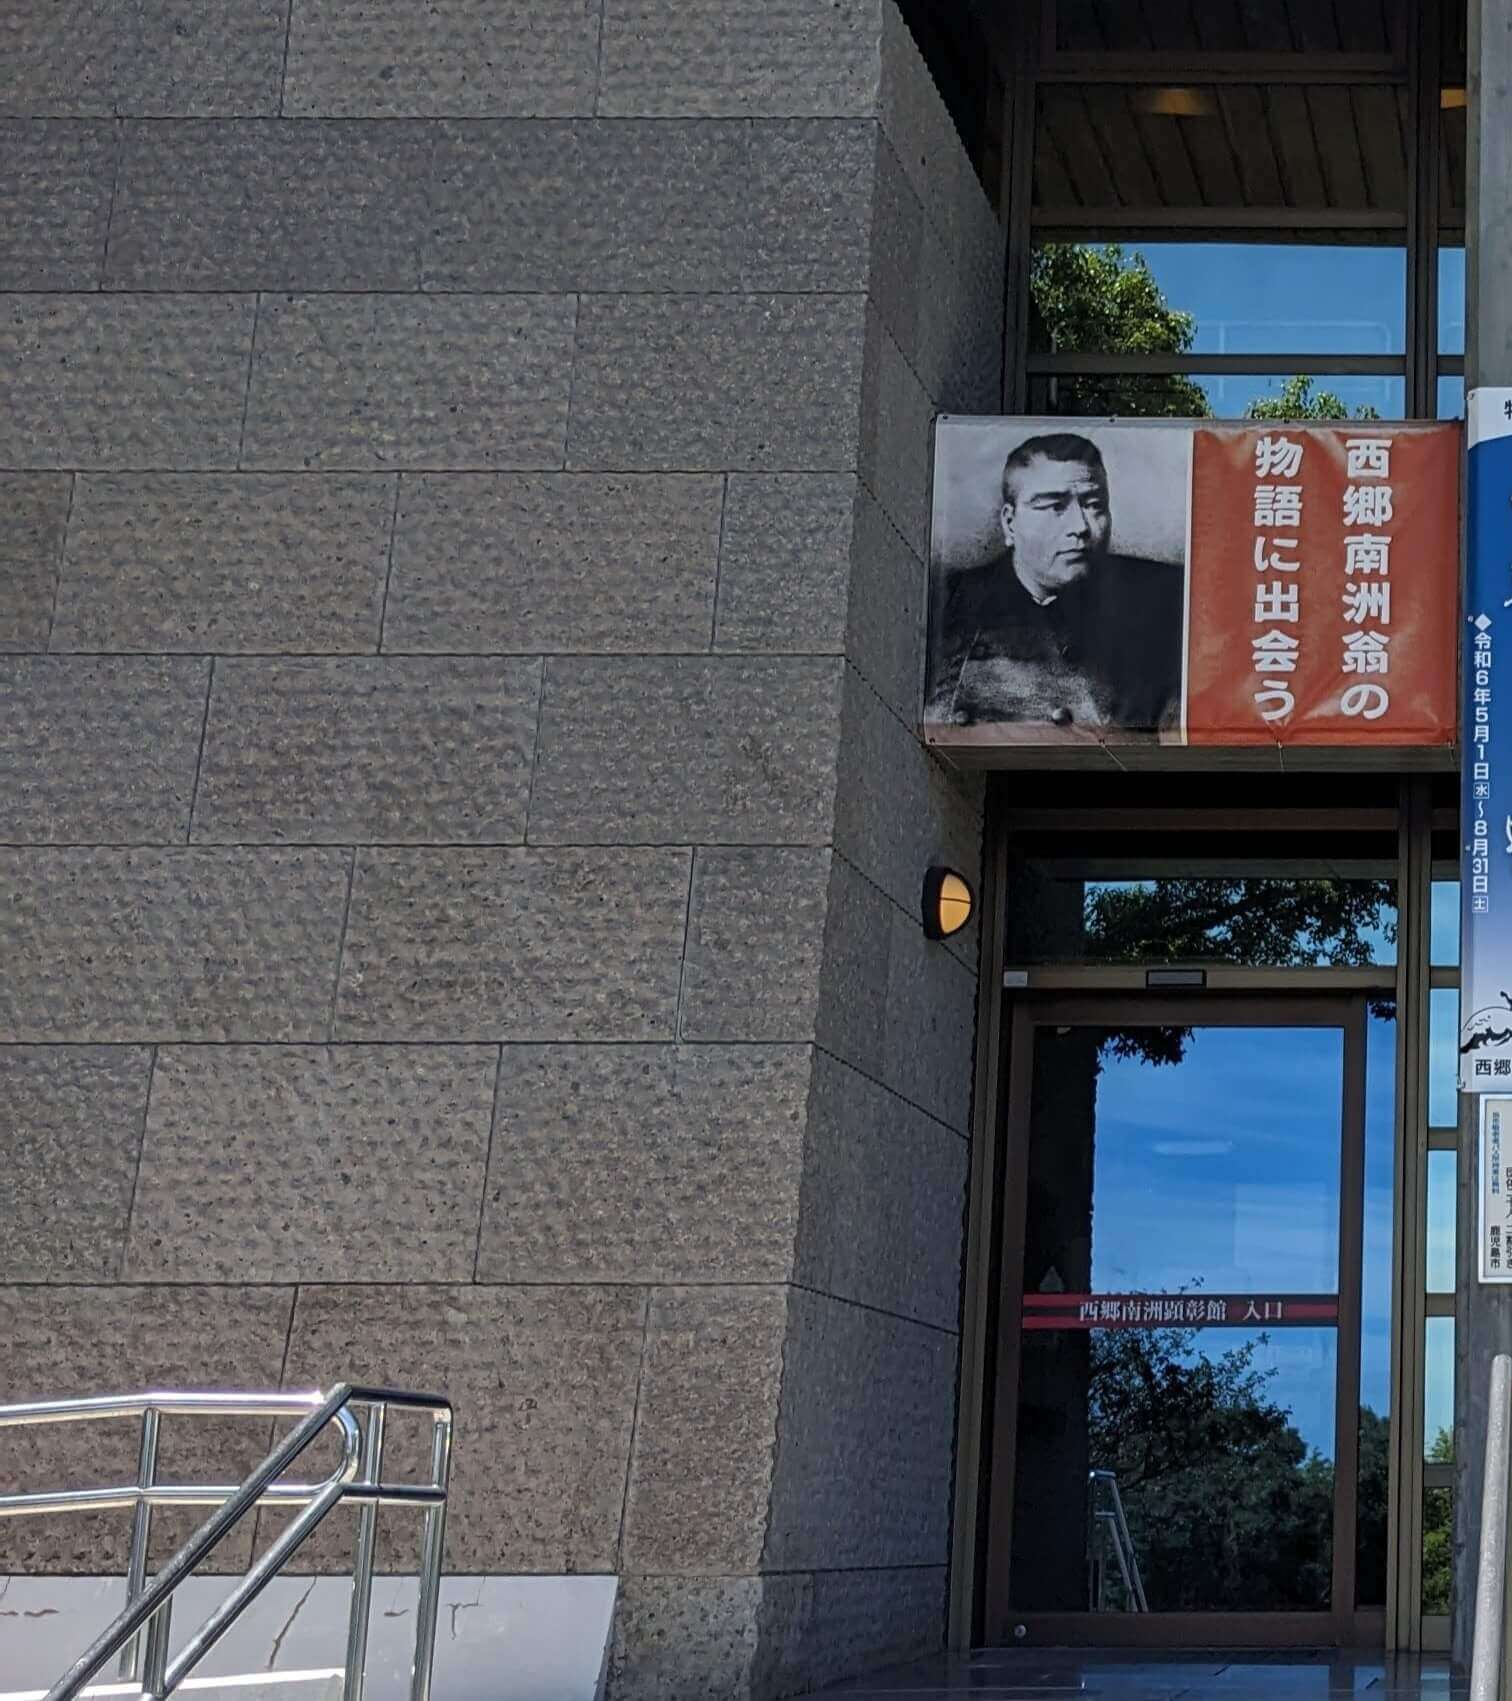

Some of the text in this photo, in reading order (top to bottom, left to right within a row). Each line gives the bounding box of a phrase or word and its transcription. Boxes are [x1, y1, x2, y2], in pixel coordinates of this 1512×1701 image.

[1251, 436, 1302, 721] 物語に出会う
[1340, 438, 1393, 720] 西郷南洲翁の
[1079, 1300, 1283, 1322] 西郷南洲顕彰館 入口
